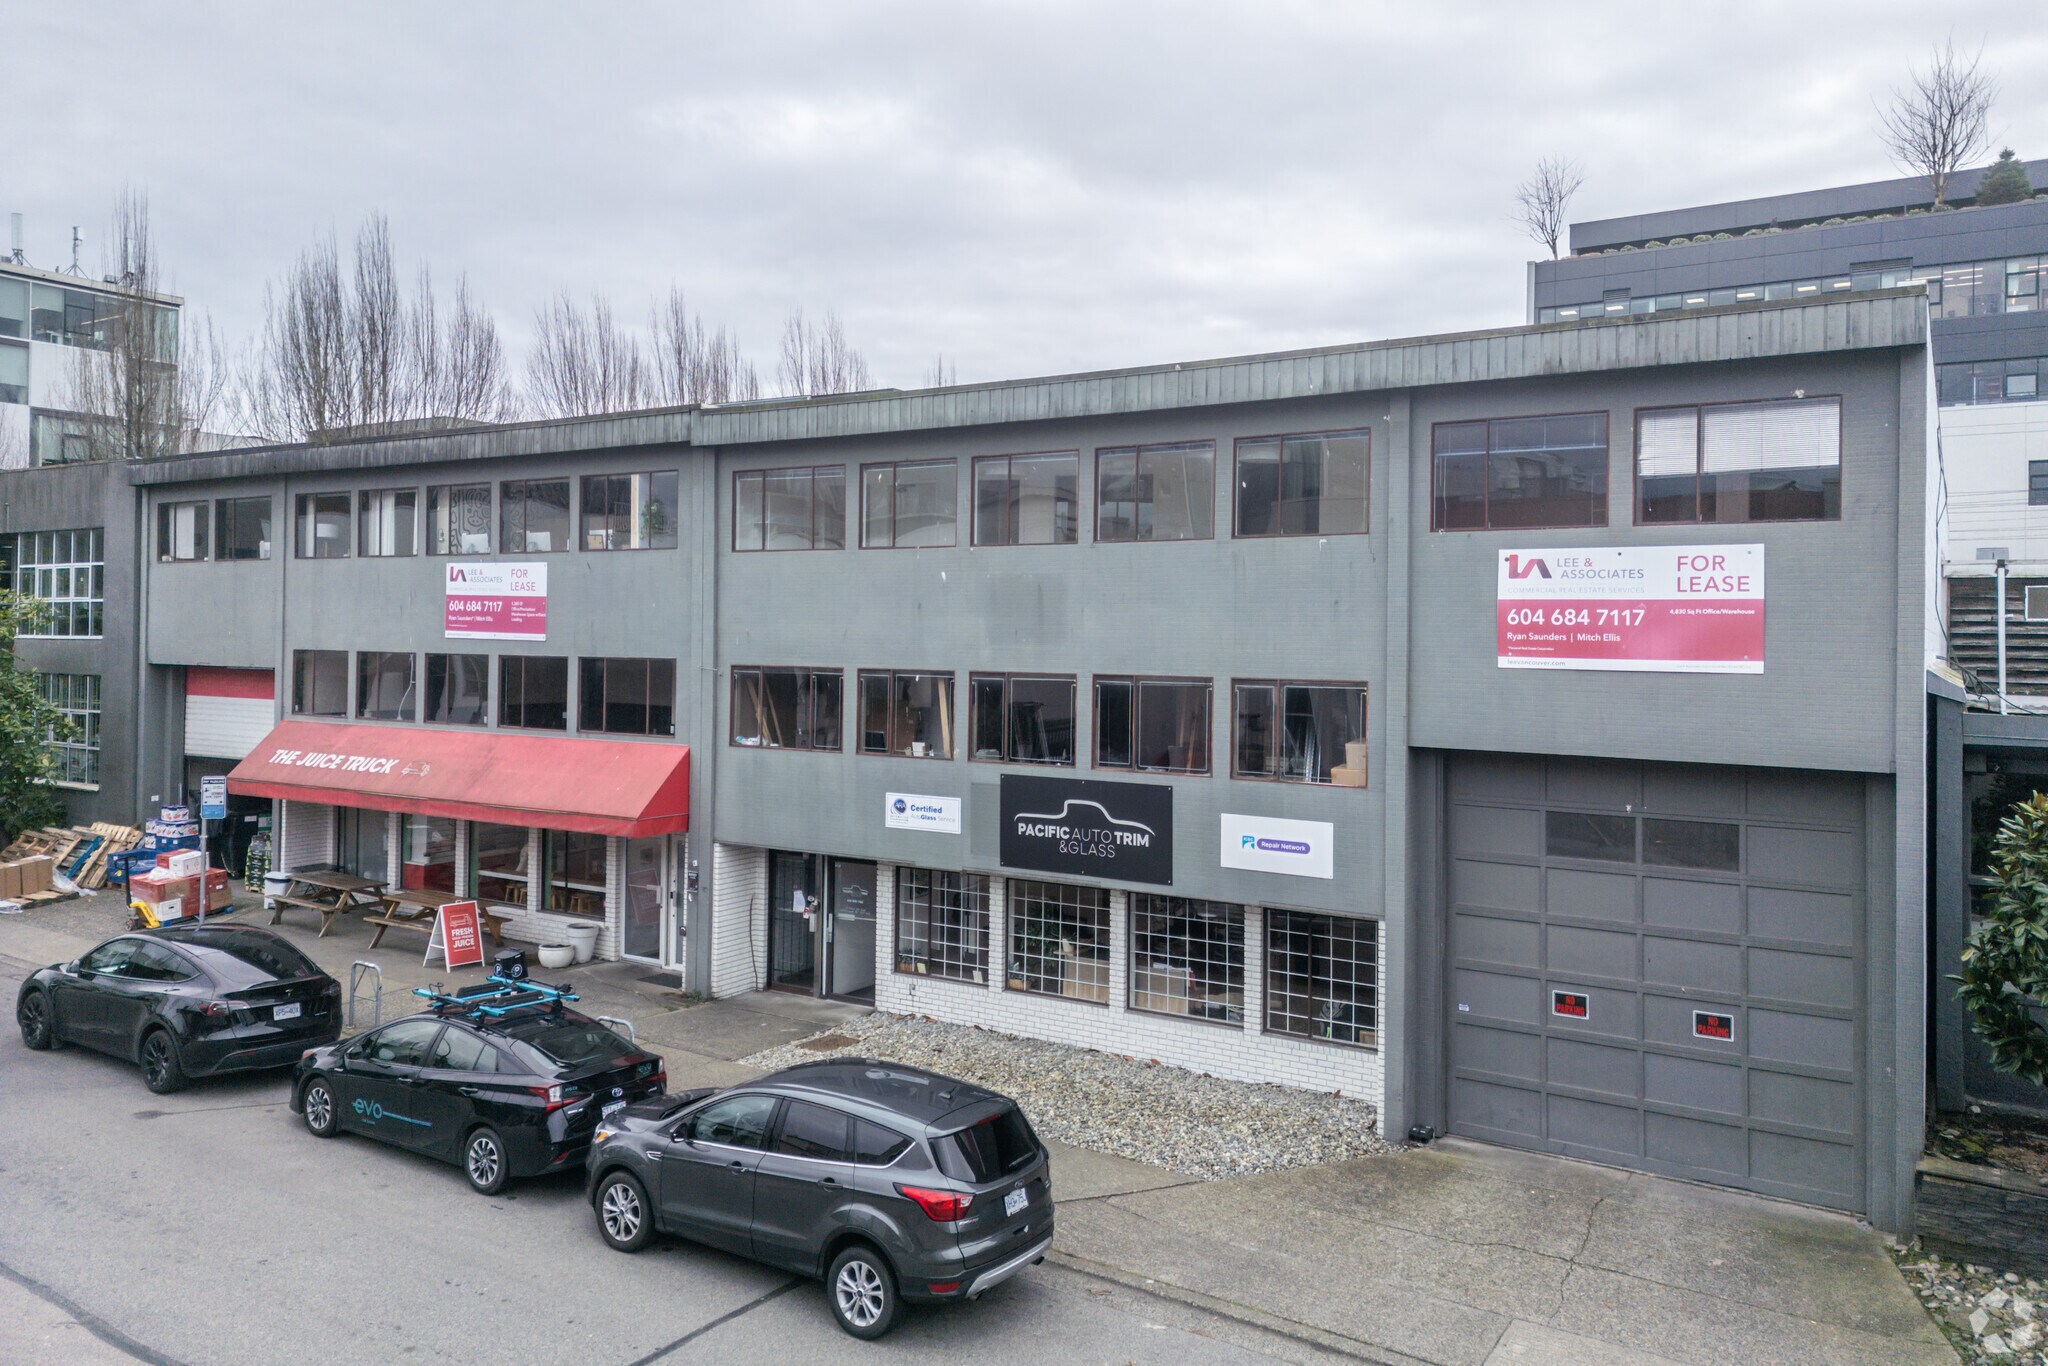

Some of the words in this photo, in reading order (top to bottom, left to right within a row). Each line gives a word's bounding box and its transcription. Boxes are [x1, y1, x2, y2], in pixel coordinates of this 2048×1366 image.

[1557, 558, 1579, 568] LEE
[1584, 557, 1592, 568] &
[1677, 555, 1726, 572] FOR
[511, 569, 528, 578] FOR
[1560, 568, 1645, 580] ASSOCIATES
[510, 582, 536, 592] LEASE
[1677, 576, 1751, 593] LEASE
[449, 600, 464, 611] 604
[466, 601, 481, 612] 684
[483, 601, 502, 612] 7117
[1507, 608, 1545, 626] 604
[1550, 608, 1590, 626] 684
[1596, 609, 1646, 626] 7117
[1507, 632, 1527, 642] Ryan
[1528, 632, 1567, 641] Saunders
[1577, 633, 1601, 642] Mitch
[1603, 634, 1621, 642] Ellis
[268, 749, 301, 764] THE
[296, 752, 346, 769] JUICE
[341, 756, 400, 774] TRUCK
[910, 804, 943, 814] Certified
[1018, 822, 1070, 839] PACIFIC
[1072, 828, 1112, 843] AUTO
[1114, 832, 1149, 847] TRIM
[1059, 840, 1115, 858] &GLASS
[451, 927, 473, 937] FRESH
[453, 938, 474, 948] JUICE
[1566, 995, 1575, 1005] NO
[1556, 1003, 1585, 1016] PARKING
[1708, 1016, 1718, 1026] NO
[1698, 1024, 1729, 1038] PARKING
[352, 1098, 382, 1119] evo
